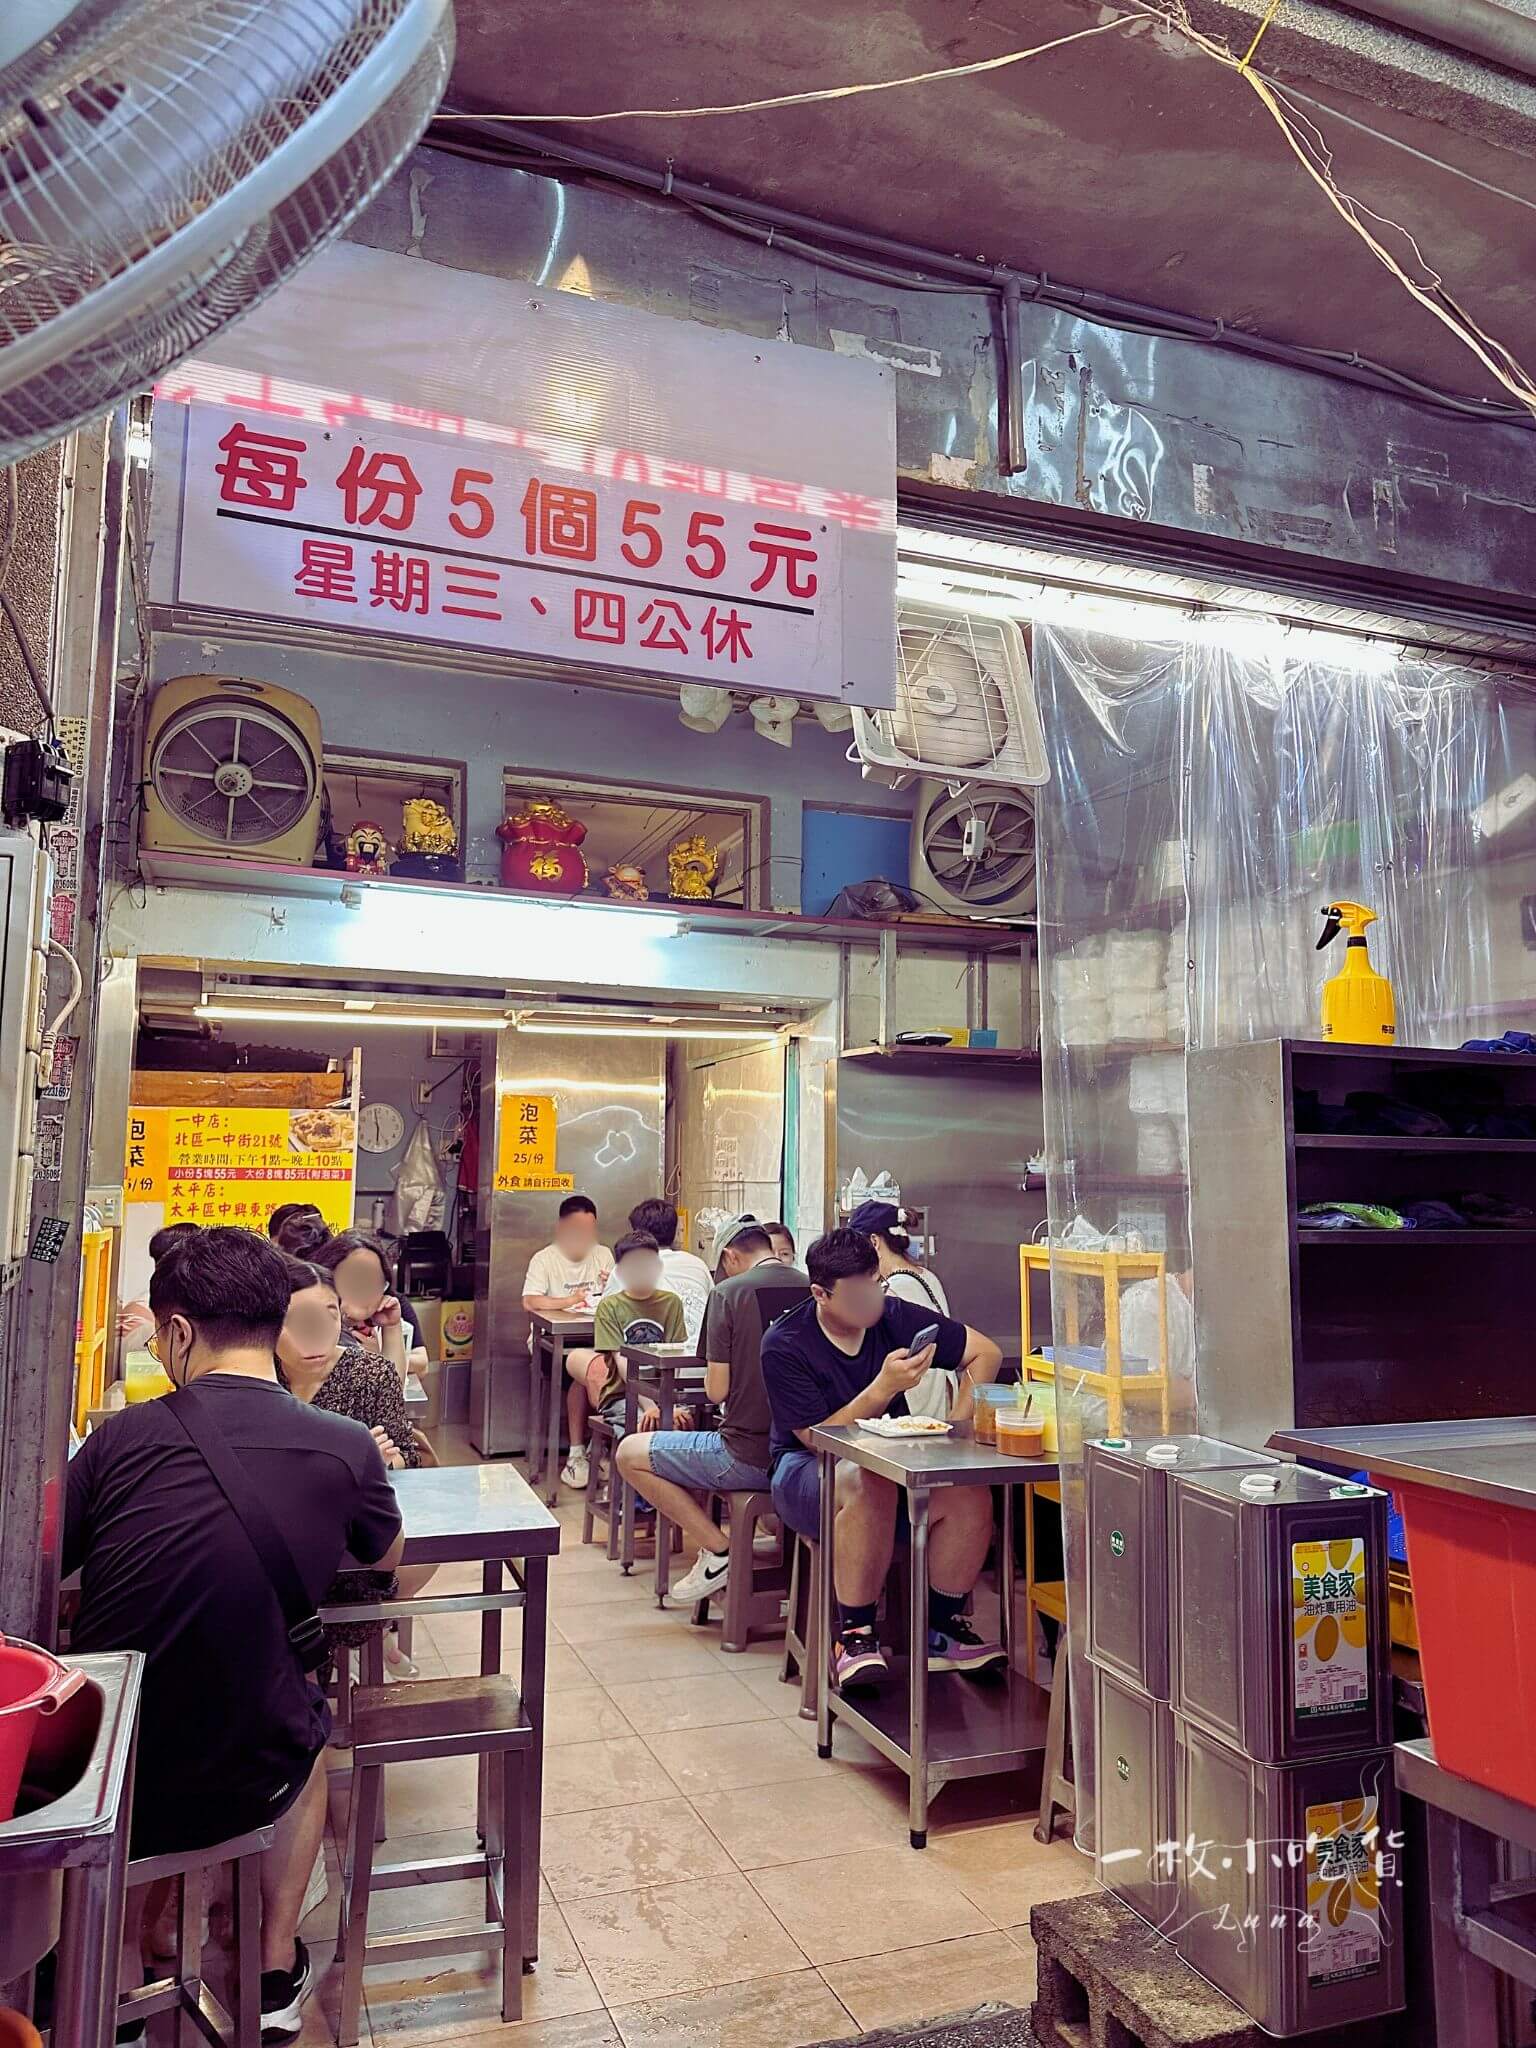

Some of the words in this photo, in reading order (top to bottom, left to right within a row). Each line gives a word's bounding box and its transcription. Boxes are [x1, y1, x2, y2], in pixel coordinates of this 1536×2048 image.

[214, 423, 819, 599] 每份5個55元
[294, 538, 754, 664] 星期三、四公休
[529, 850, 563, 882] 福
[520, 1103, 538, 1145] 泡菜
[175, 1133, 283, 1148] 北區一中街21號
[513, 1153, 544, 1165] 25/份
[498, 1175, 521, 1188] 外食
[524, 1178, 570, 1188] 請自行回收
[1304, 1570, 1356, 1601] 美食家
[1304, 1600, 1357, 1617] 油炸專用油
